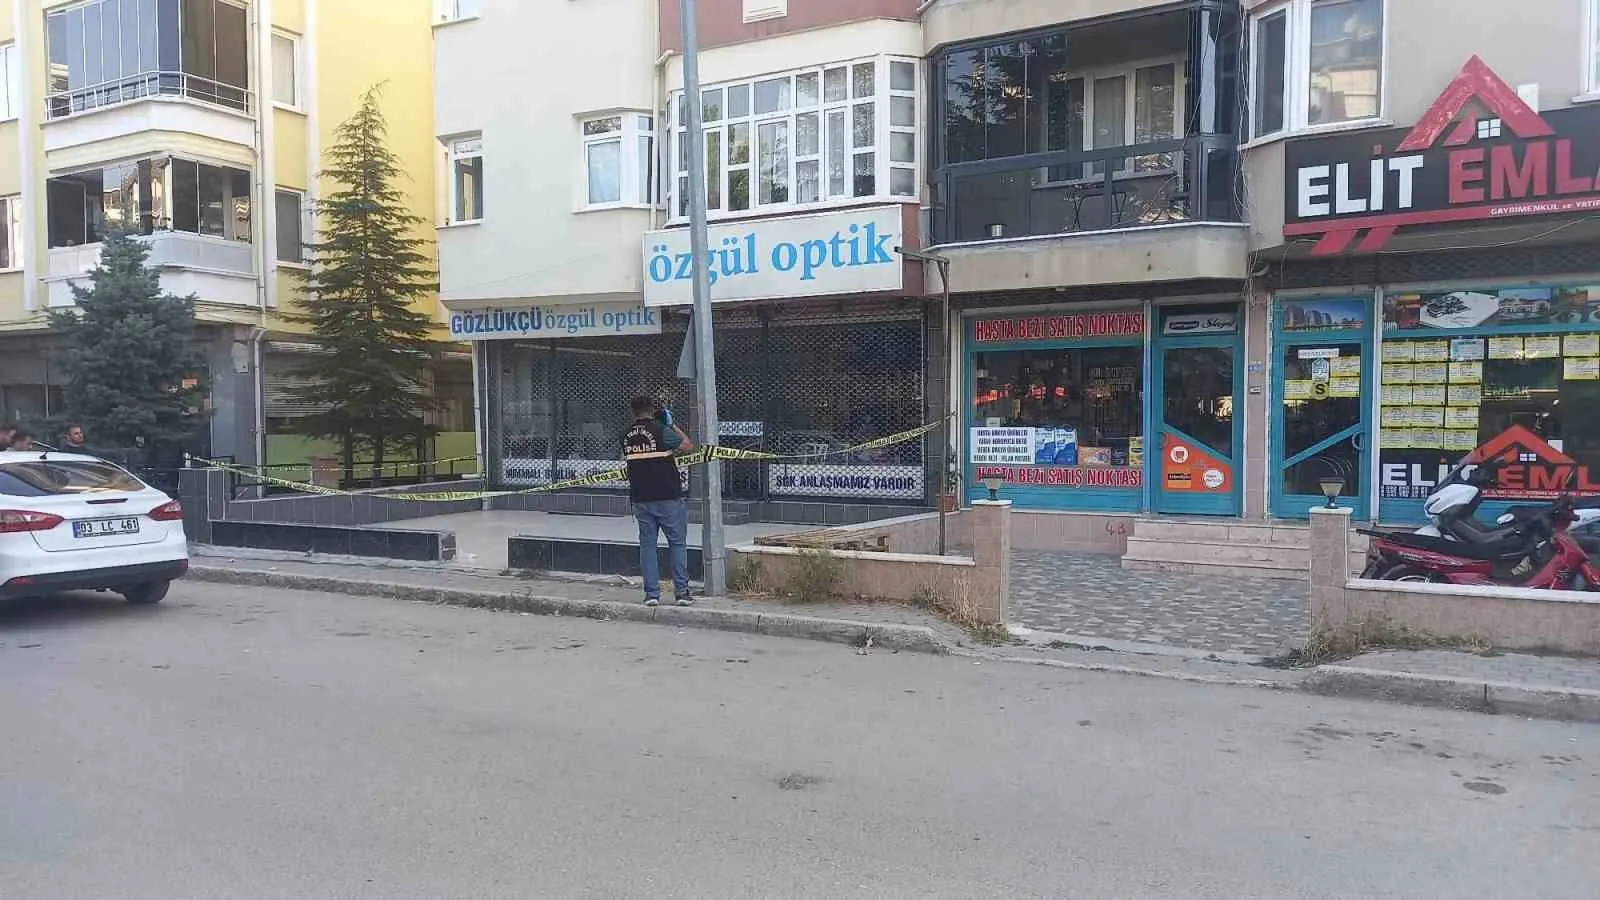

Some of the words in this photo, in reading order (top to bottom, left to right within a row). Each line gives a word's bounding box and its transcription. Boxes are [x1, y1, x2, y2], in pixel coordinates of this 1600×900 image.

[1298, 143, 1424, 217] ELİT
[1450, 138, 1600, 203] EML
[771, 221, 894, 281] optik
[451, 306, 542, 335] GÖZLÜKÇÜ
[545, 306, 597, 333] özgül
[602, 304, 656, 332] optik
[976, 320, 1014, 341] HASTA
[800, 475, 870, 491] ANLAŞMAMIZ
[873, 476, 914, 490] VARDIR
[1087, 466, 1143, 487] NOKTASI
[81, 522, 92, 533] 03
[101, 521, 113, 531] LC
[121, 519, 137, 530] 461
